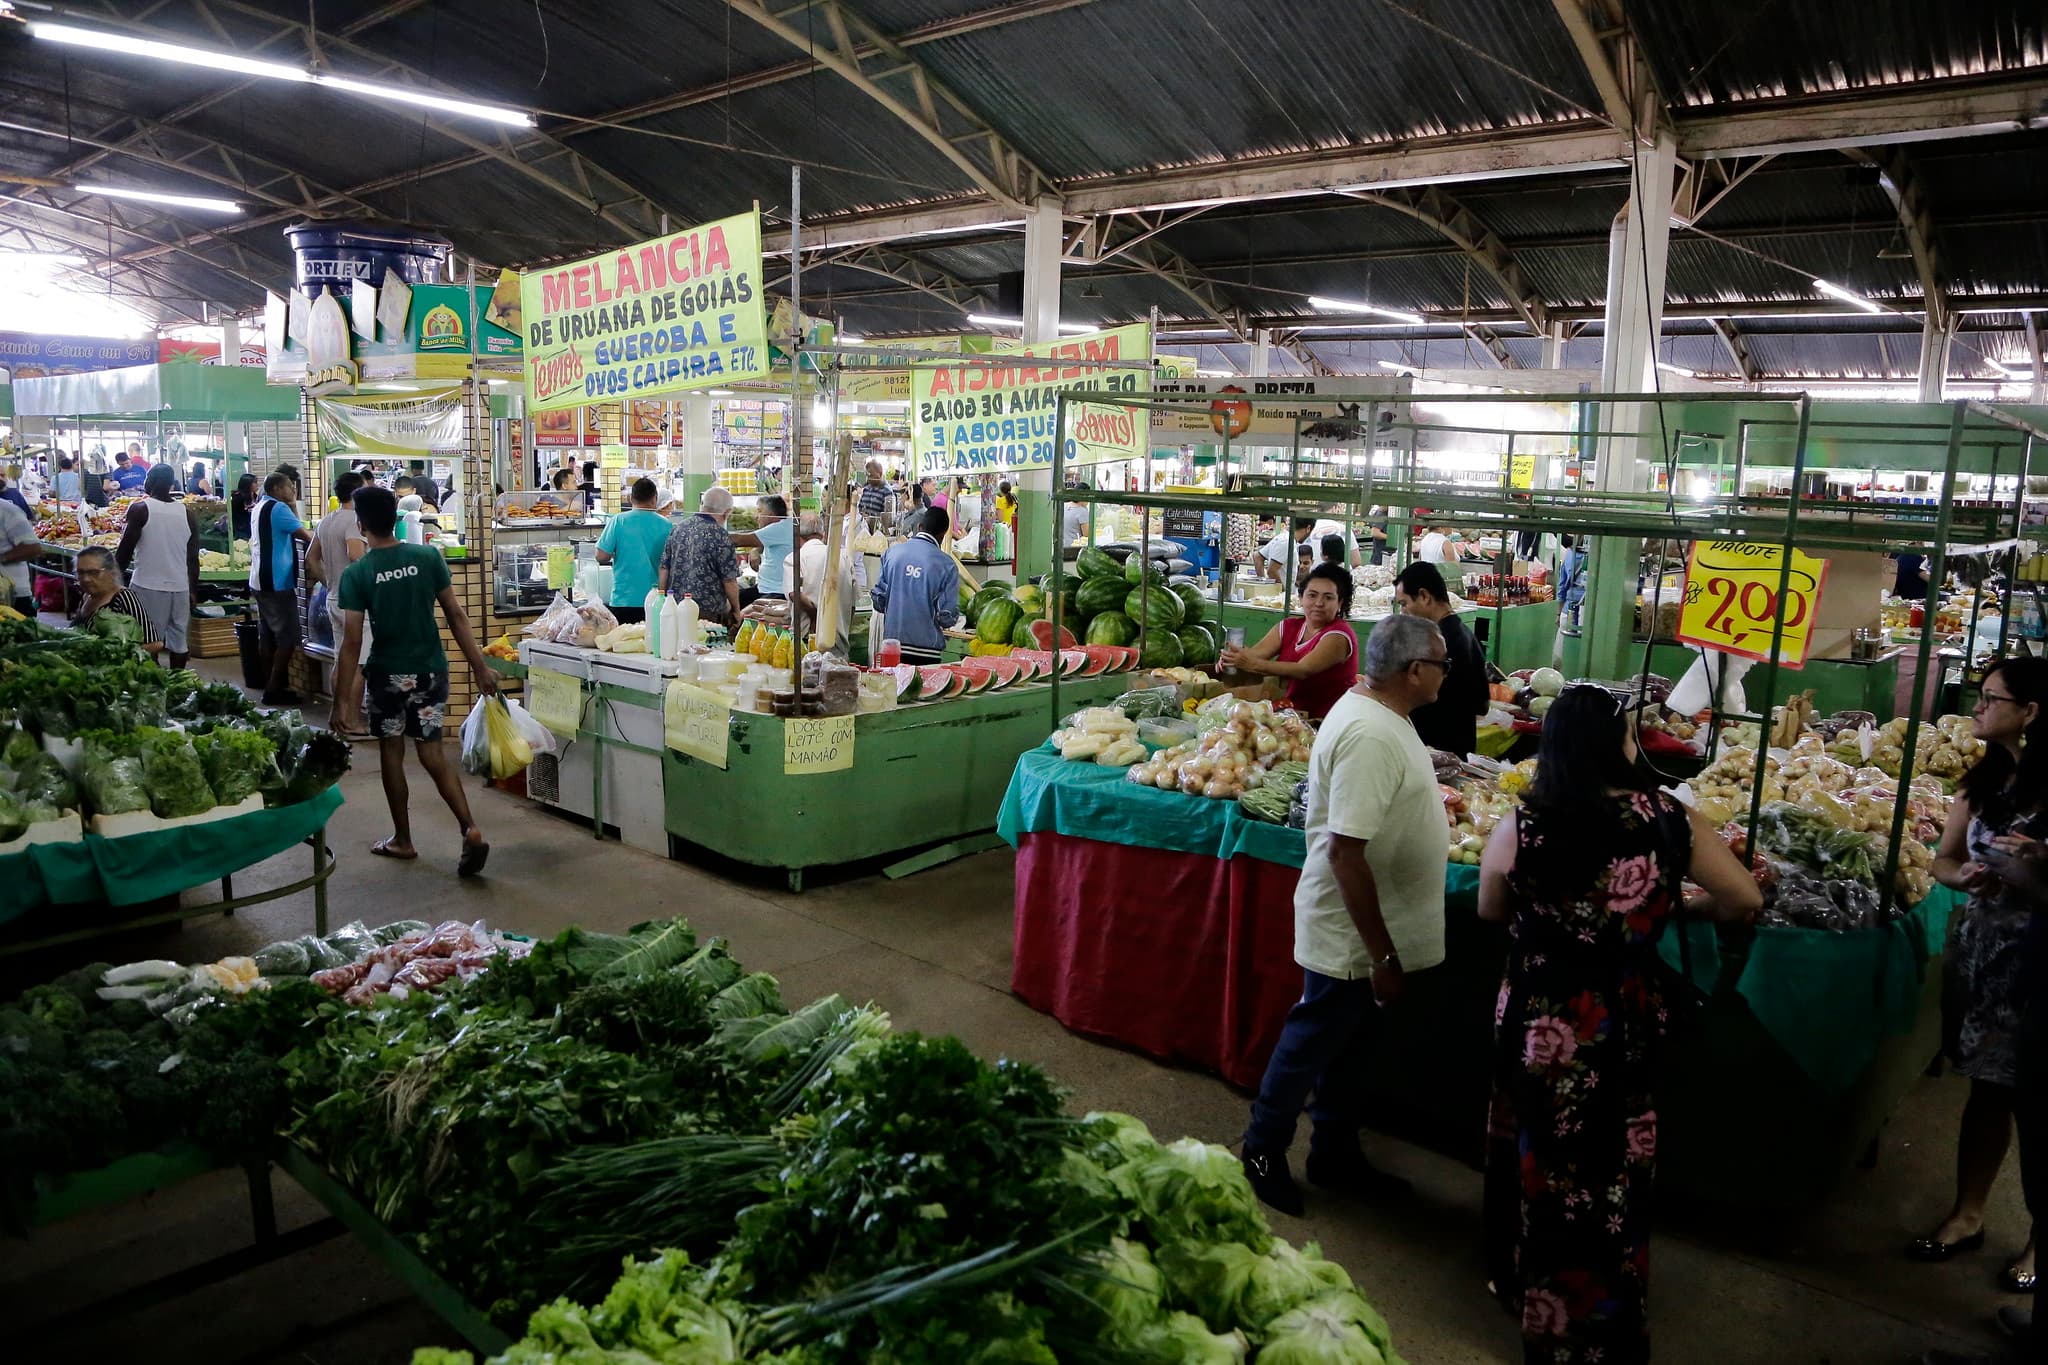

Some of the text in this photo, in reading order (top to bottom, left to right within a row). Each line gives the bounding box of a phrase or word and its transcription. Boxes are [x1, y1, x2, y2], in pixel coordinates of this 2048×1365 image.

[530, 271, 753, 347] DE URUANA DE GOIÁS
[595, 313, 737, 365] GUEROBA E
[585, 367, 628, 398] OVOS
[633, 351, 724, 390] CAIPIRA
[1286, 410, 1297, 418] na
[376, 565, 418, 584] APOIO
[905, 564, 922, 578] 96
[831, 729, 852, 745] COM
